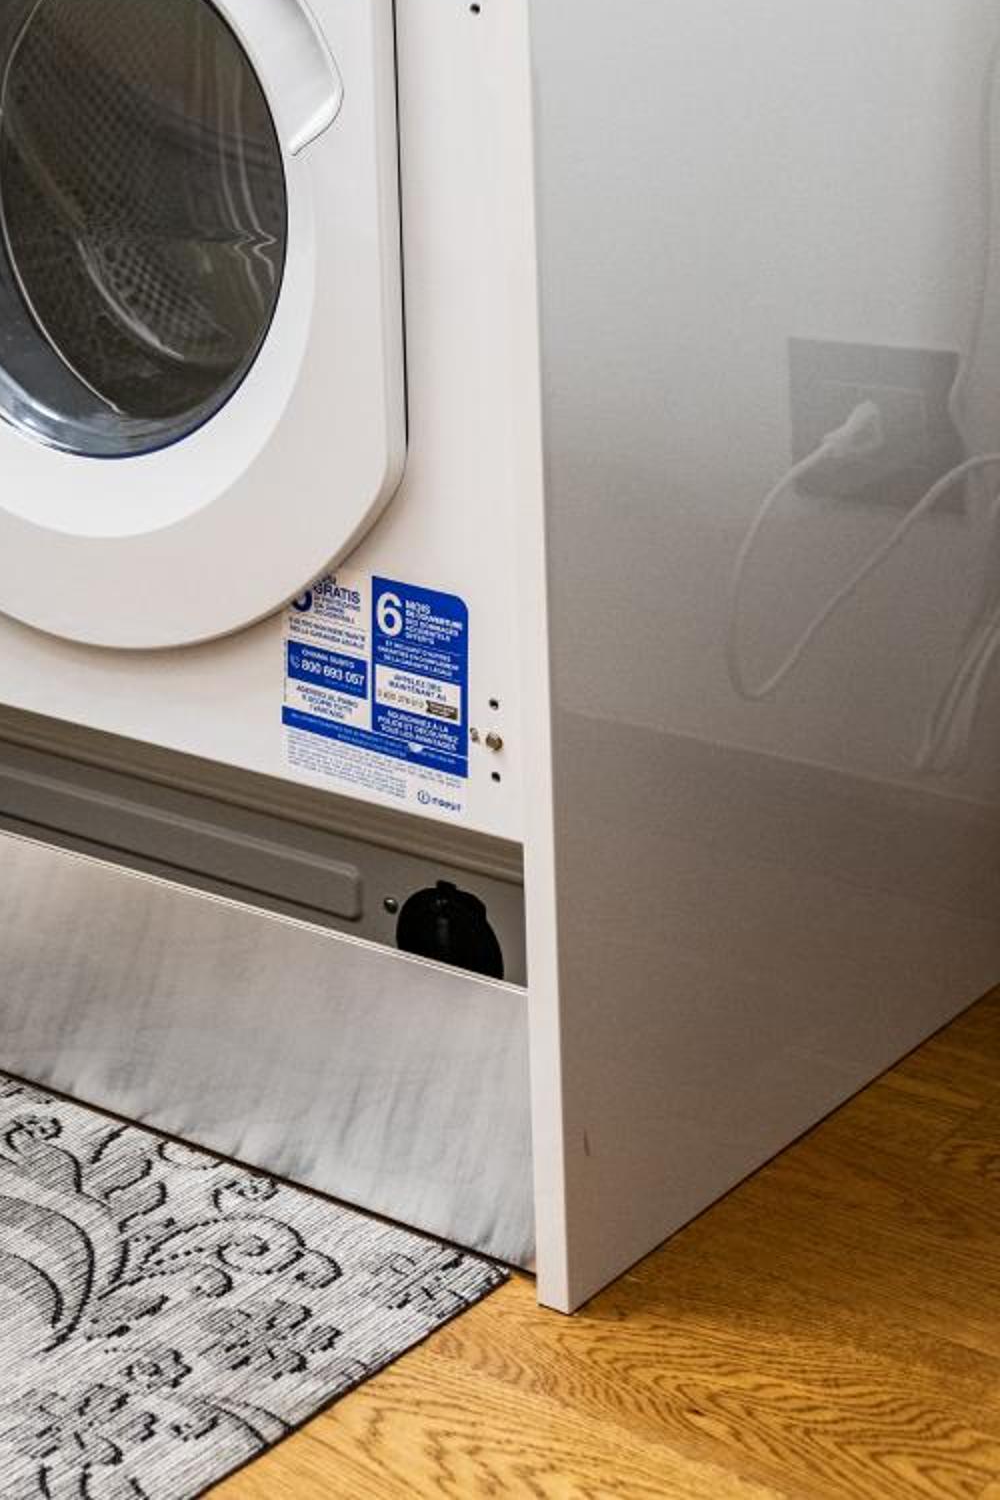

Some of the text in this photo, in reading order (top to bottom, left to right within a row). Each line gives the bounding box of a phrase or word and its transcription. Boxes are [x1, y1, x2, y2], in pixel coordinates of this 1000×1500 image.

[312, 581, 361, 605] GRATIS
[377, 592, 403, 637] 6
[301, 658, 323, 675] 800
